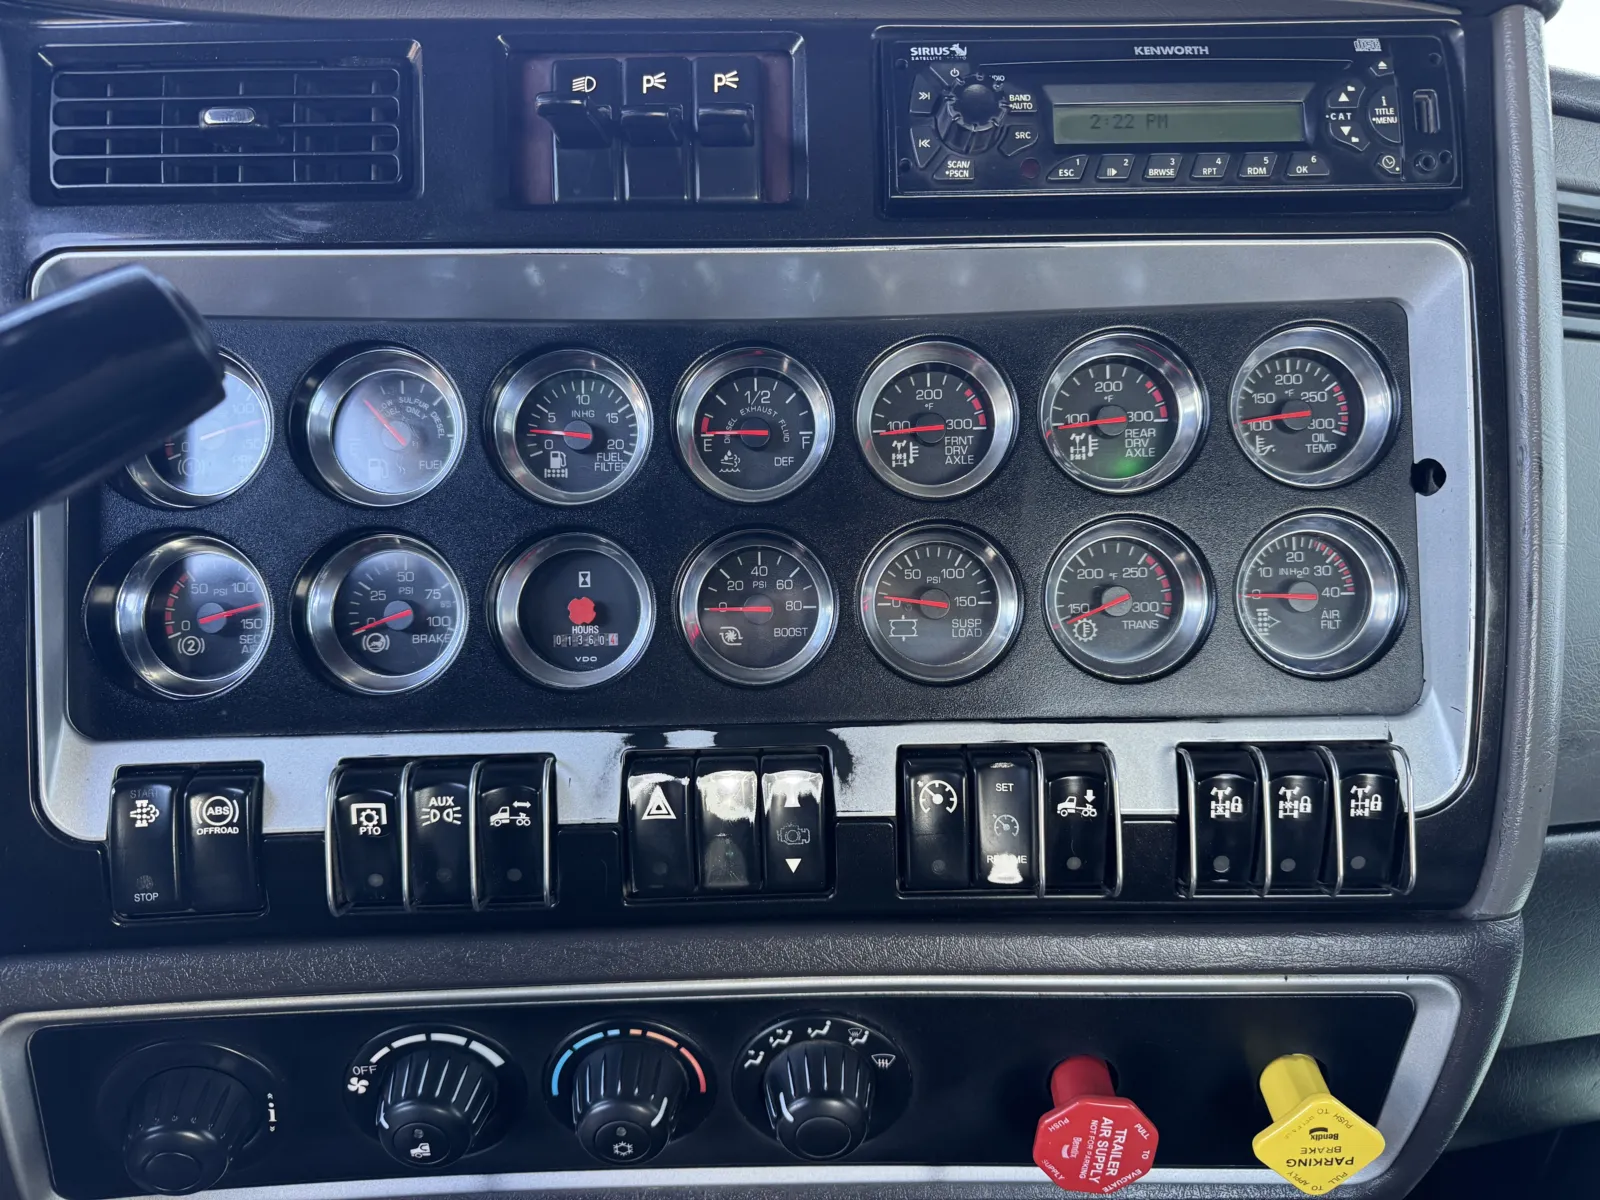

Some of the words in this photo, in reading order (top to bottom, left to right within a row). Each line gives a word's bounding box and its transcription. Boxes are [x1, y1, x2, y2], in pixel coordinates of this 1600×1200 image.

[910, 46, 950, 56] SIRIUS
[1134, 46, 1209, 55] KENWORTH
[1009, 94, 1032, 102] BAND
[1012, 102, 1033, 110] AUTO
[1374, 107, 1395, 115] TITLE
[1089, 113, 1135, 129] 2:22
[1146, 113, 1168, 129] PM
[1375, 116, 1398, 124] MENU
[1015, 131, 1031, 140] SRC
[947, 160, 971, 168] SCAN/
[1075, 158, 1080, 166] 1
[1123, 158, 1129, 166] 2
[1169, 157, 1175, 165] 3
[1215, 157, 1222, 165] 4
[1263, 156, 1269, 164] 5
[1310, 155, 1316, 163] 6
[949, 169, 970, 178] PSCN
[1058, 168, 1074, 177] ESC
[1148, 168, 1175, 176] BRWSE
[1202, 167, 1217, 175] RPT
[1247, 166, 1267, 175] RDM
[1296, 165, 1308, 174] OK
[1274, 373, 1303, 385] 200
[1094, 380, 1123, 392] 200
[575, 394, 590, 405] 10
[744, 390, 771, 406] 1/2
[915, 389, 943, 400] 200
[1251, 392, 1276, 404] 150
[1300, 391, 1328, 403] 250
[398, 396, 430, 411] SULFUR
[430, 411, 445, 439] DIESEL
[406, 406, 428, 420] ONLY
[547, 412, 556, 423] 5
[605, 412, 619, 423] 15
[1064, 413, 1090, 424] 100
[1127, 411, 1154, 423] 300
[723, 417, 738, 444] DSEL
[739, 406, 779, 418] EXHAUST
[778, 418, 790, 443] FLUID
[886, 420, 911, 431] 100
[946, 418, 973, 430] 300
[1247, 420, 1273, 431] 100
[1307, 418, 1335, 430] 300
[1125, 428, 1156, 438] REAR
[1311, 433, 1329, 443] OIL
[544, 439, 553, 450] 0
[606, 439, 624, 450] 20
[703, 438, 713, 452] E
[801, 436, 811, 450] F
[944, 435, 974, 445] FRNT
[1125, 438, 1149, 448] DRV
[944, 445, 968, 455] DRV
[1125, 448, 1156, 457] AXLE
[1305, 444, 1337, 453] TEMP
[596, 452, 623, 461] FUEL
[774, 456, 794, 467] DEF
[944, 455, 974, 465] AXLE
[419, 460, 444, 470] FUEL
[594, 462, 628, 471] FILTER
[1285, 551, 1304, 563] 20
[750, 566, 768, 577] 40
[904, 569, 922, 580] 50
[940, 568, 965, 579] 100
[1077, 568, 1103, 580] 200
[1122, 567, 1148, 578] 250
[1257, 567, 1273, 578] 10
[1313, 565, 1332, 577] 30
[397, 572, 415, 582] 50
[926, 576, 941, 584] PSI
[190, 583, 209, 594] 50
[231, 582, 256, 593] 100
[727, 580, 744, 591] 20
[752, 581, 767, 589] PSI
[776, 579, 793, 590] 60
[213, 588, 228, 596] PSI
[370, 590, 387, 601] 25
[398, 587, 414, 595] PSI
[424, 588, 441, 600] 75
[1321, 587, 1340, 598] 40
[718, 601, 728, 613] 0
[785, 600, 803, 611] 80
[891, 598, 901, 608] 0
[953, 596, 977, 607] 150
[1067, 603, 1091, 614] 150
[1131, 602, 1159, 613] 300
[1320, 609, 1340, 619] AIR
[181, 620, 191, 631] 0
[240, 618, 264, 630] 150
[426, 616, 450, 627] 100
[951, 618, 982, 628] SUSP
[1122, 620, 1159, 630] TRANS
[1320, 619, 1342, 629] FILT
[572, 625, 599, 634] HOURS
[773, 627, 808, 637] BOOST
[951, 628, 982, 638] LOAD
[412, 634, 451, 644] BRAKE
[995, 783, 1014, 792] SET
[428, 796, 455, 807] AUX
[206, 806, 230, 816] ABS
[196, 826, 240, 836] OFFROAD
[359, 827, 382, 836] PTO
[133, 892, 159, 902] STOP
[352, 1064, 378, 1076] OFF
[1047, 1117, 1070, 1133] PUSH
[1332, 1113, 1354, 1129] PUSH
[1089, 1119, 1099, 1135] NOT
[1098, 1116, 1114, 1138] AIR
[1133, 1123, 1150, 1140] PULL
[1086, 1135, 1095, 1150] FOR
[1310, 1133, 1339, 1141] Bendix
[1069, 1136, 1083, 1159] Bendix
[1105, 1128, 1128, 1177] TRAILER
[1300, 1145, 1342, 1154] BRAKE
[1141, 1149, 1150, 1160] TO
[1078, 1150, 1092, 1180] PARKING
[1088, 1140, 1109, 1184] SUPPLY
[1285, 1156, 1355, 1168] PARKING
[1041, 1159, 1066, 1181] SUPPLY
[1101, 1168, 1143, 1193] EVACUATE
[1287, 1171, 1310, 1186] APPLY
[1327, 1171, 1348, 1185] PULL
